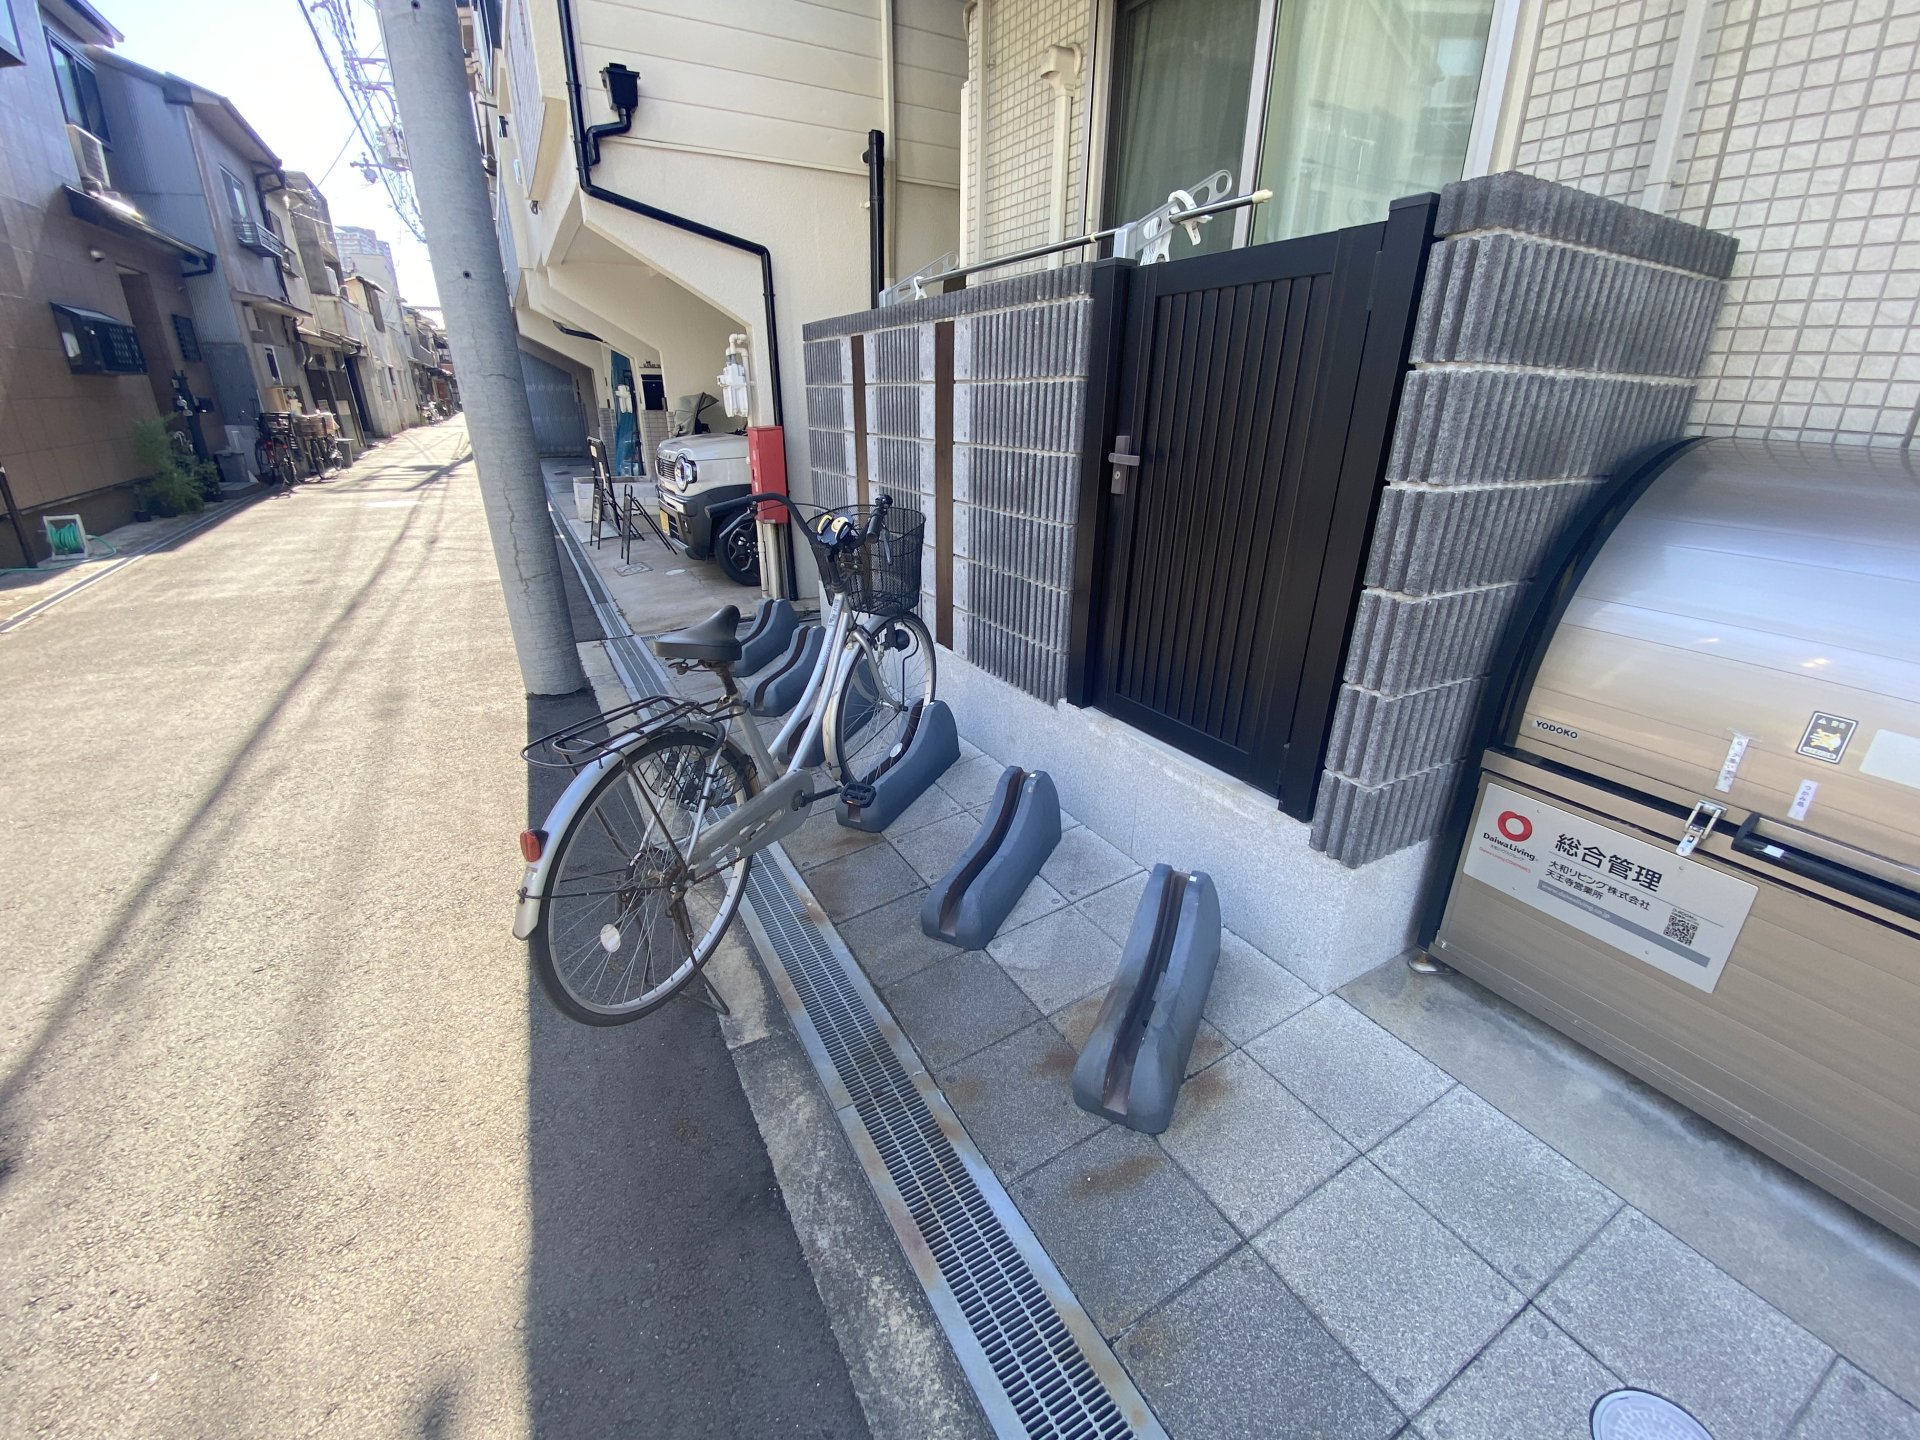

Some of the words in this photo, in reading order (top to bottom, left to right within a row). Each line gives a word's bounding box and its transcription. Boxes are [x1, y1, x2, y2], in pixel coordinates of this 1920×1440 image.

[1536, 720, 1578, 739] YODOKO
[1555, 834, 1662, 892] 総合管理
[1545, 868, 1604, 900] 天王寺営業所
[1549, 860, 1651, 911] 大和リビング株式会社
